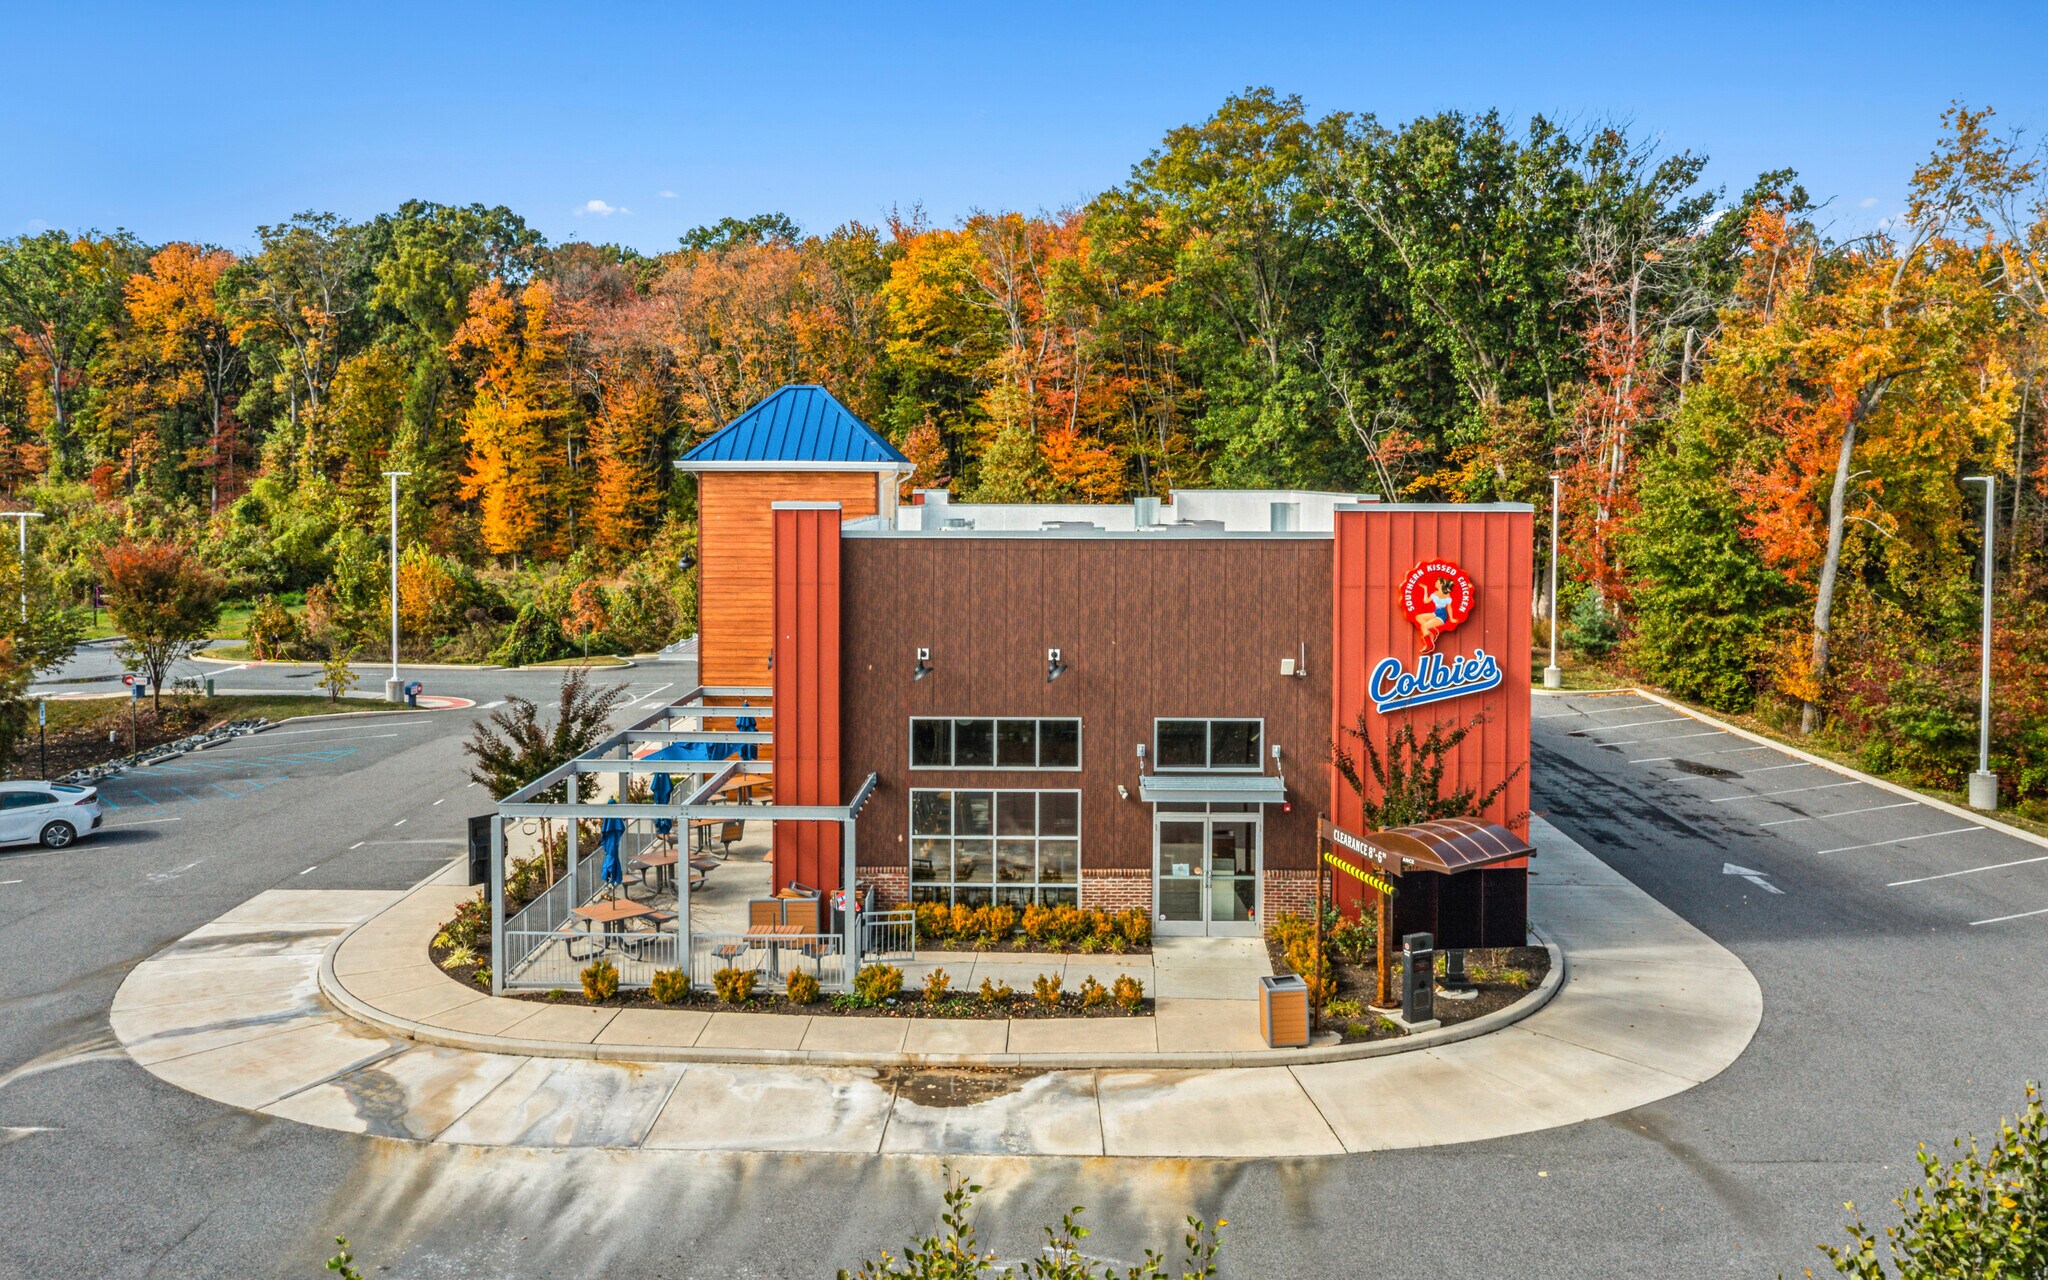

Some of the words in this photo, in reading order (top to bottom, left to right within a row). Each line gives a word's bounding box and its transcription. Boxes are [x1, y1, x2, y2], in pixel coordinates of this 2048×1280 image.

[1405, 569, 1424, 612] SOUTHERN
[1426, 564, 1457, 576] KISSED
[1457, 576, 1470, 612] CHICKEN
[1369, 649, 1501, 706] Colbie's
[1333, 829, 1368, 857] CLEARANCE
